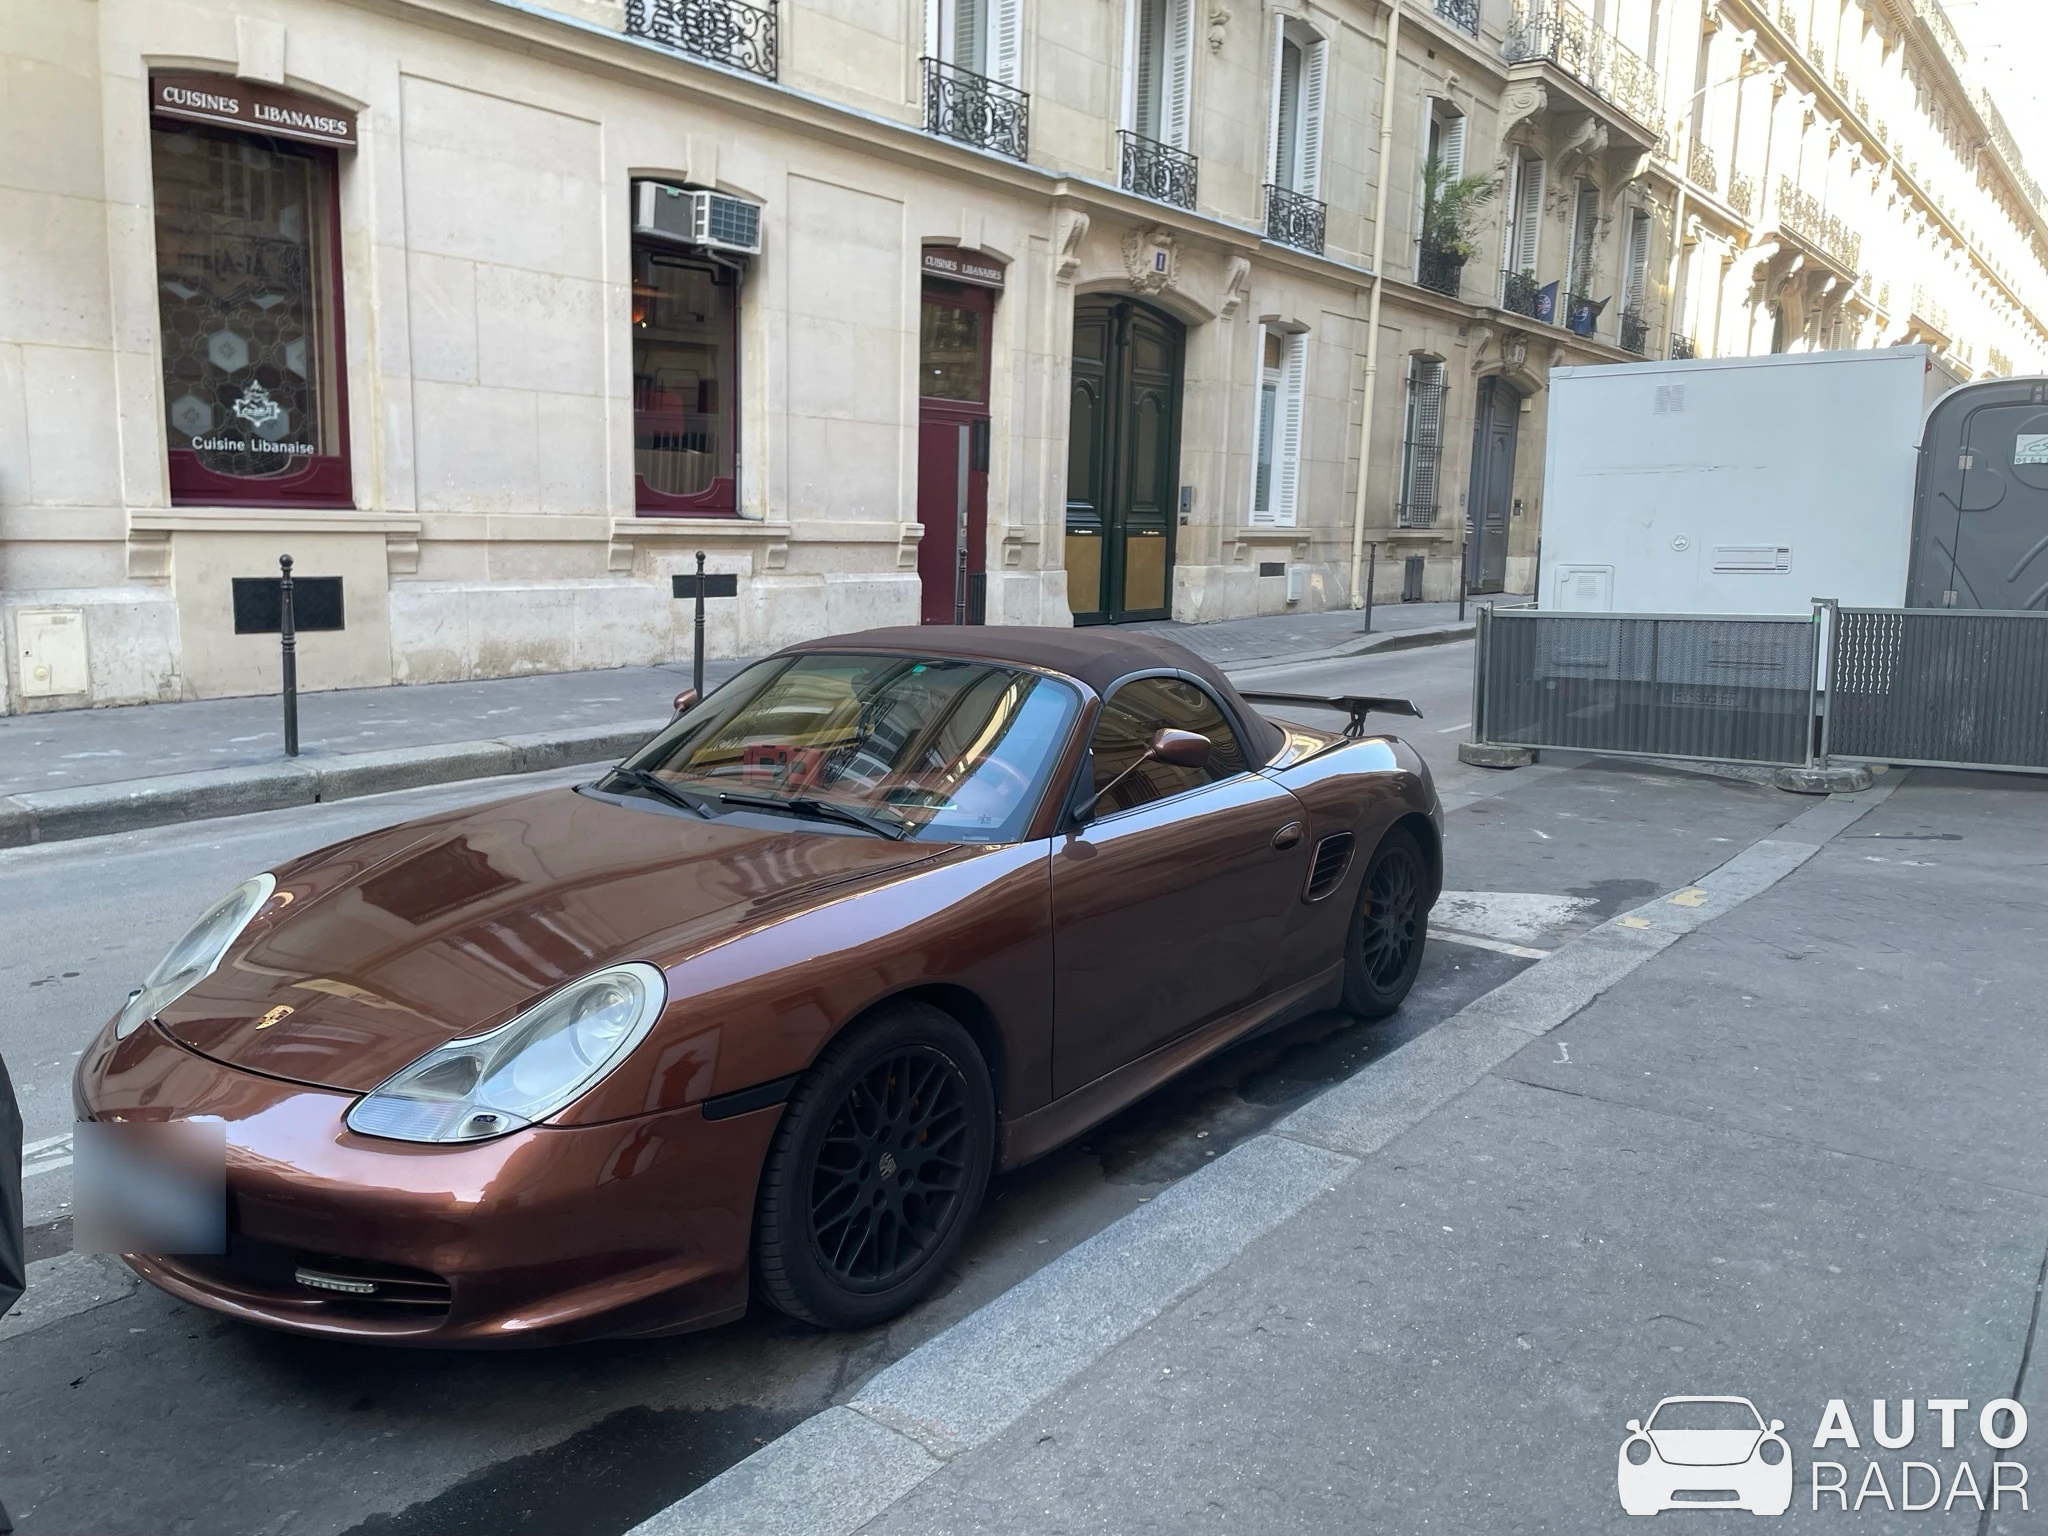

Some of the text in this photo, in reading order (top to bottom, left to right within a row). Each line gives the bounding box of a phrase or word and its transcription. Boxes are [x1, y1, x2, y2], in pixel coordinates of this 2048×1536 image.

[162, 86, 348, 136] CUISINES LIBANAISES
[924, 255, 1002, 280] CUISINES LIBANAISES
[191, 435, 315, 455] Cuisine Libanaise
